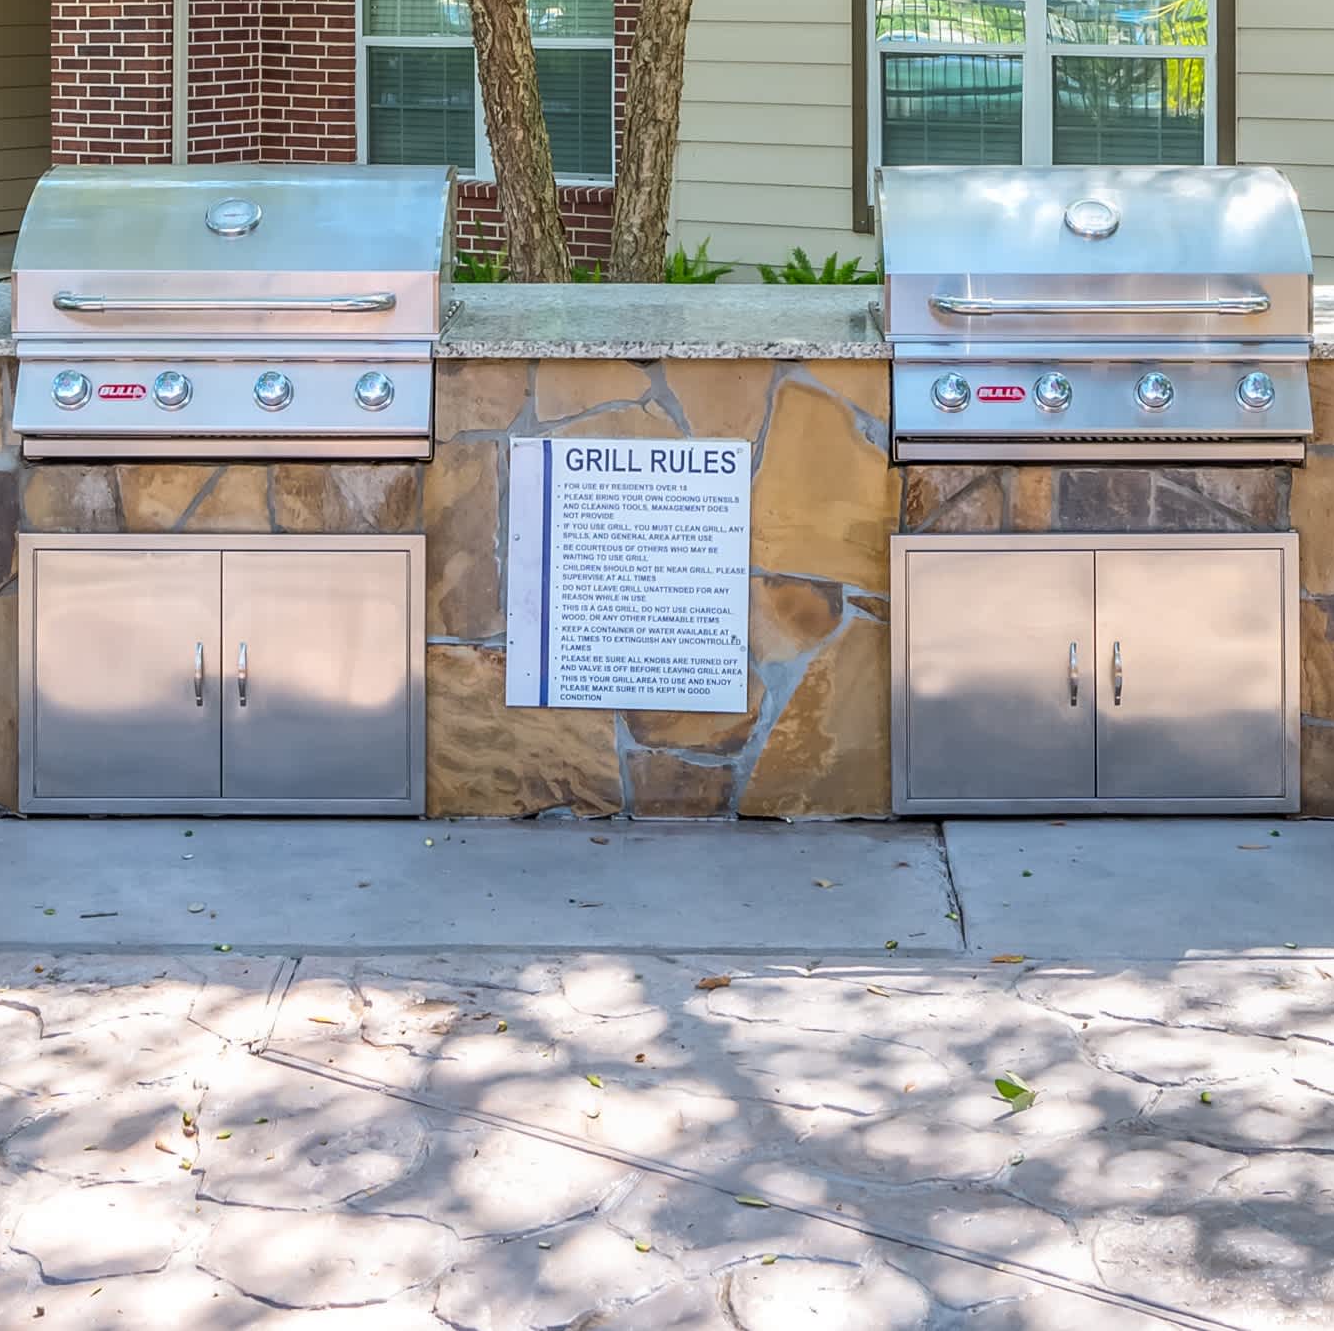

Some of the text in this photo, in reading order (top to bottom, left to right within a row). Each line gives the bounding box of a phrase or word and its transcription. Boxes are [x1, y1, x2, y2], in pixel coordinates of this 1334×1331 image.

[565, 447, 736, 474] GRILL RULES
[651, 504, 705, 512] MANAGEMENT
[648, 615, 694, 623] FLAMMABLE
[678, 637, 741, 645] UNCONTROLLED
